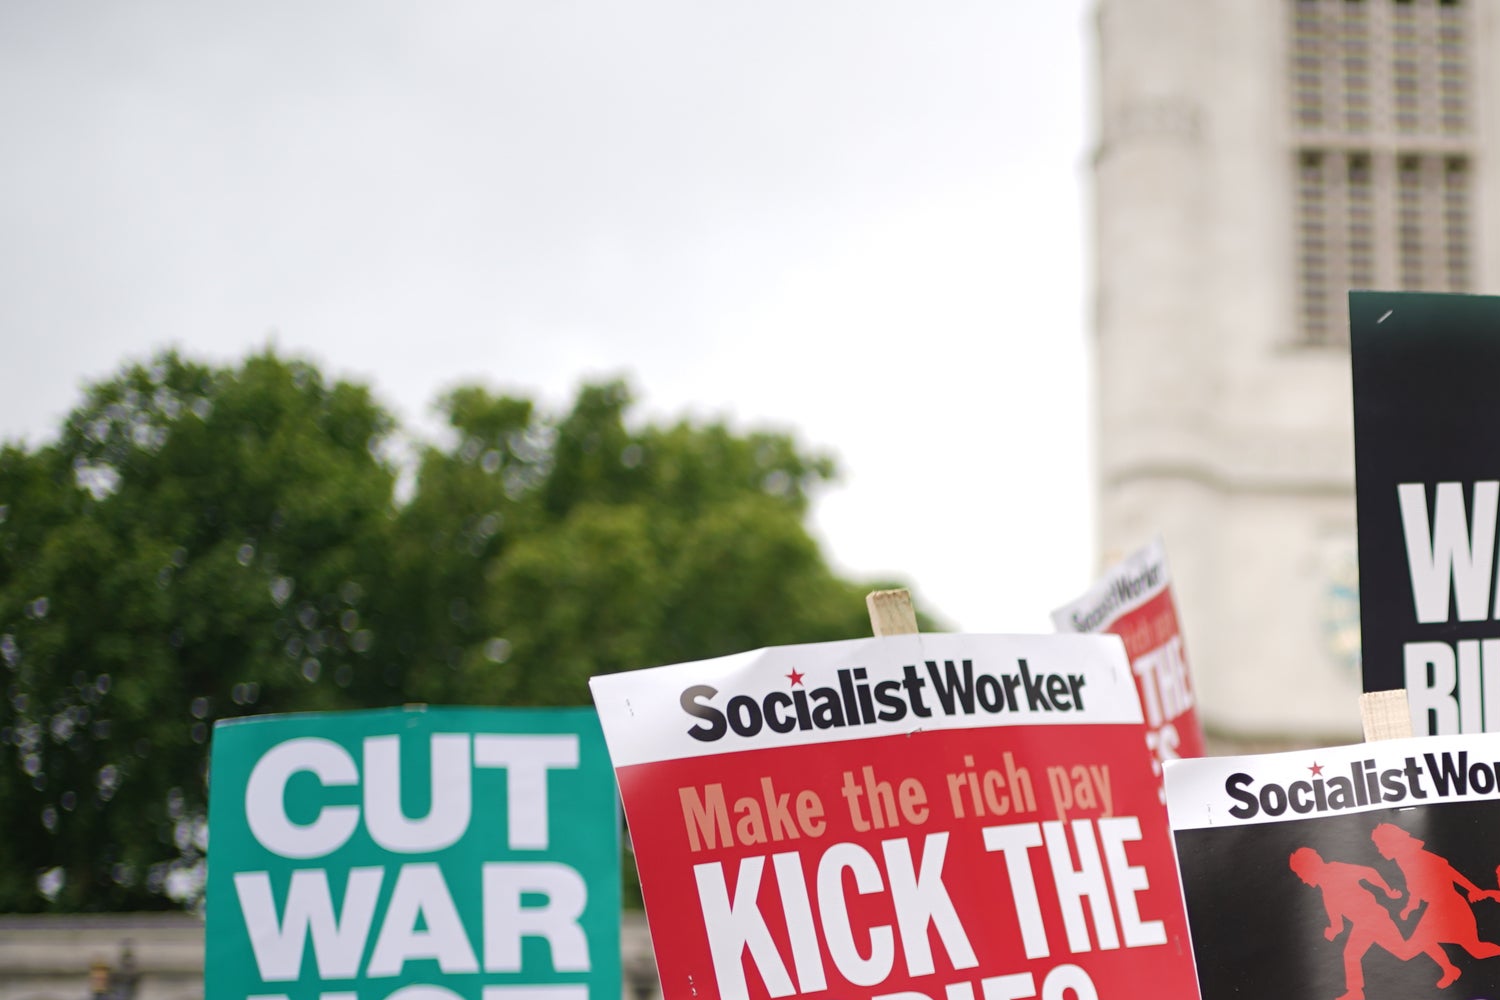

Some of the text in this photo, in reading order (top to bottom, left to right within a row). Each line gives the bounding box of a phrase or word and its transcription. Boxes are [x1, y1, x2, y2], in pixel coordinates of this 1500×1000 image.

[245, 734, 579, 858] CUT
[678, 776, 827, 852] Make
[842, 766, 929, 832] the
[946, 752, 1037, 819] rich
[1046, 764, 1113, 823] pay
[234, 862, 590, 981] WAR
[982, 816, 1168, 959] THE
